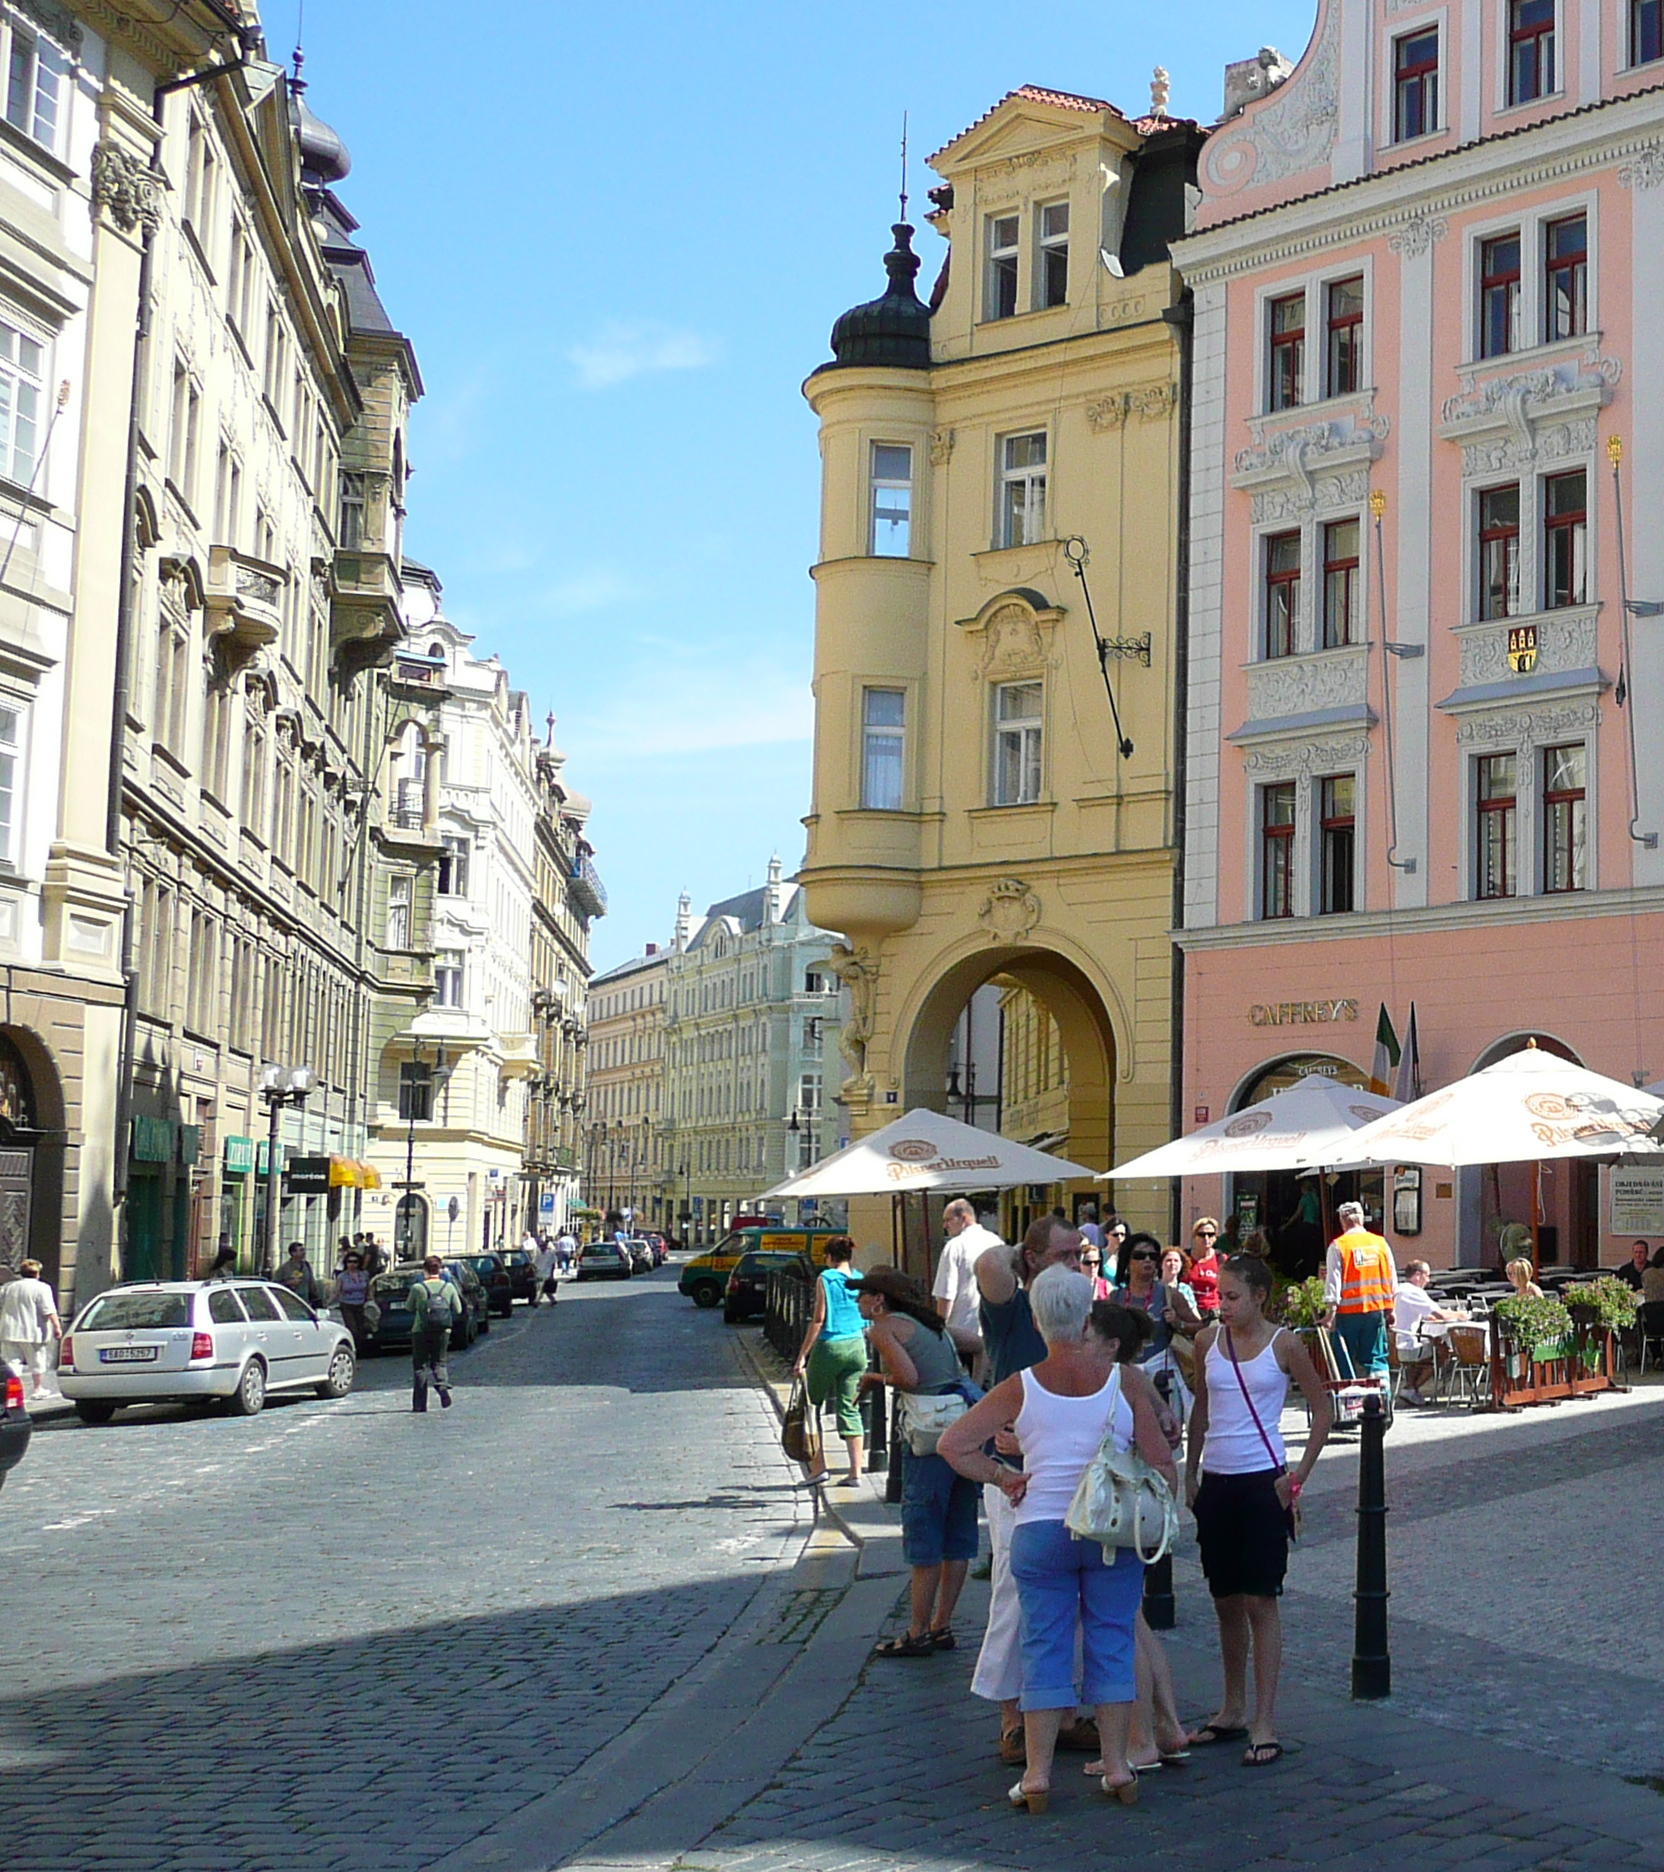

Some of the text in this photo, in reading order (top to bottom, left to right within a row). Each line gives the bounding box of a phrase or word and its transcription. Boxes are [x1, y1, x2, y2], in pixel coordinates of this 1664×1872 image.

[1249, 999, 1358, 1026] CAFFREY'S
[886, 1155, 1001, 1181] Pilsner Urquell
